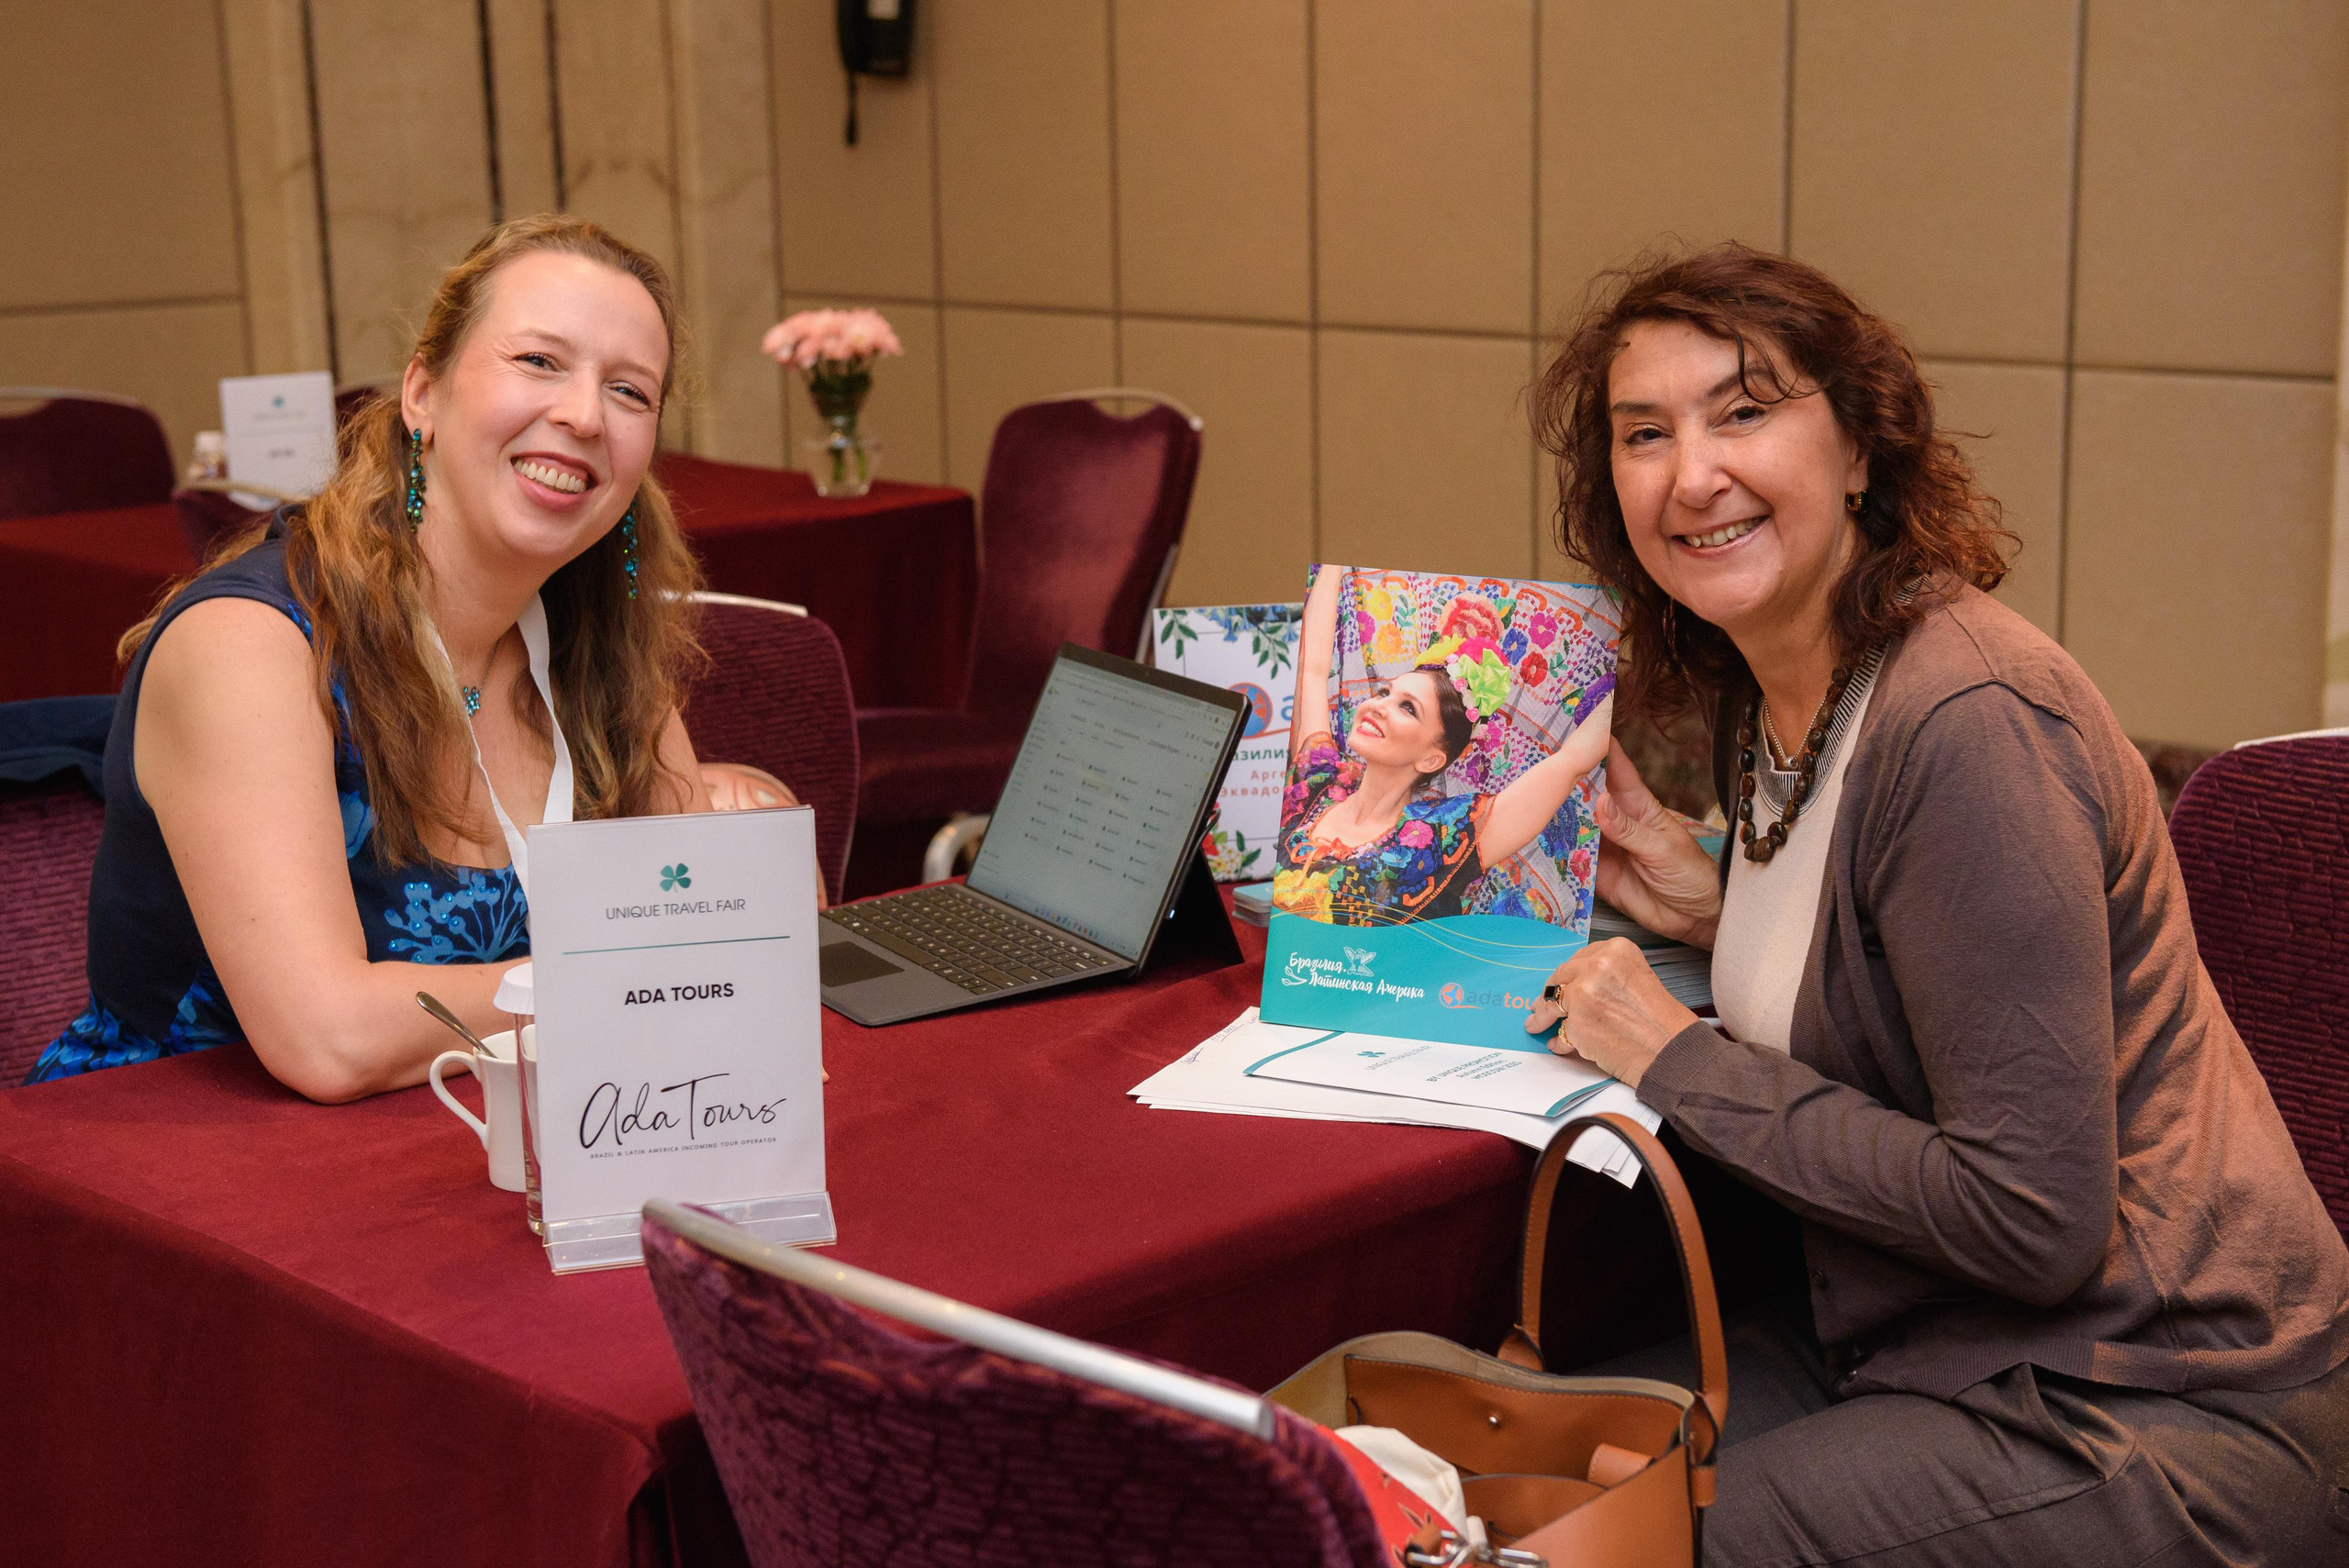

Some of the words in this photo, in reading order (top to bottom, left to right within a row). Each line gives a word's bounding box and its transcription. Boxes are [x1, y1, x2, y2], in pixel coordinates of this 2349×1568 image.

[1233, 749, 1289, 762] азили
[1251, 770, 1286, 781] Арге
[1219, 785, 1280, 797] Эквадо
[606, 905, 661, 919] UNIQUE
[664, 901, 713, 915] TRAVEL
[717, 898, 746, 911] FAIR
[1289, 952, 1346, 973] Бразилия.
[624, 988, 666, 1006] ADA
[671, 983, 734, 1001] TOURS
[1308, 971, 1374, 994] Латинская
[1375, 979, 1426, 1002] Америка
[1466, 990, 1532, 1011] adatou
[741, 1137, 777, 1145] OPERATOR
